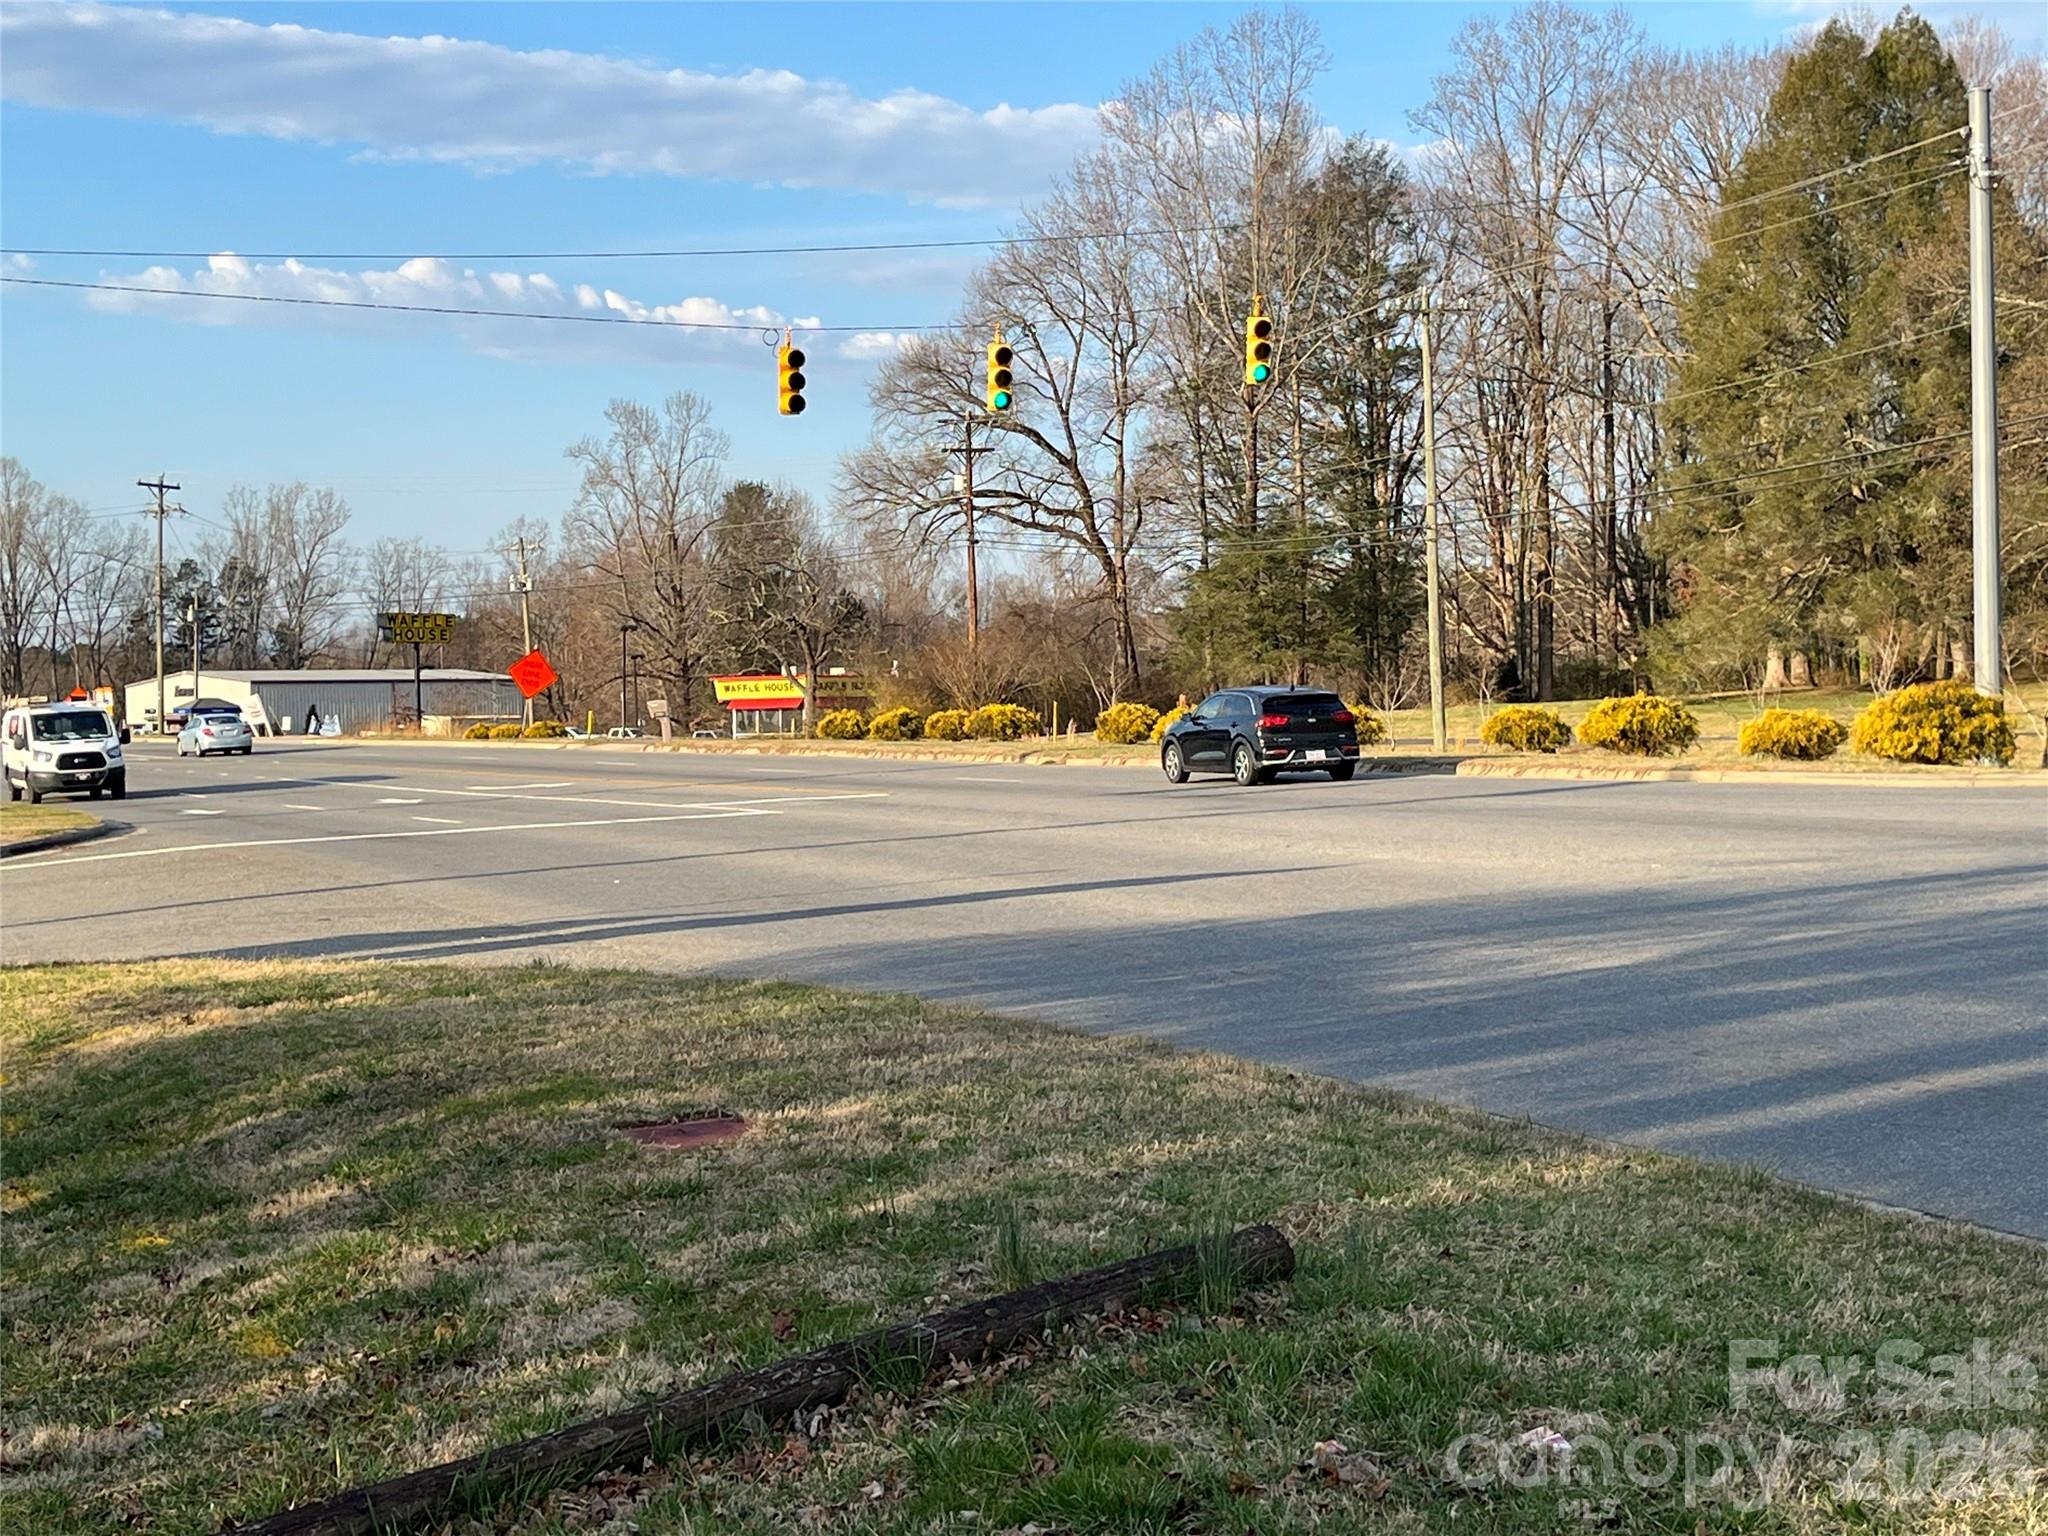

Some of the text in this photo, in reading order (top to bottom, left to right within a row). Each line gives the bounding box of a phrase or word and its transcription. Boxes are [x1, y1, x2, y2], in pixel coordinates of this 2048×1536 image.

[387, 614, 454, 627] WAFFLE
[394, 629, 448, 641] HOUSE
[723, 682, 794, 693] WAFFLE HOUSE
